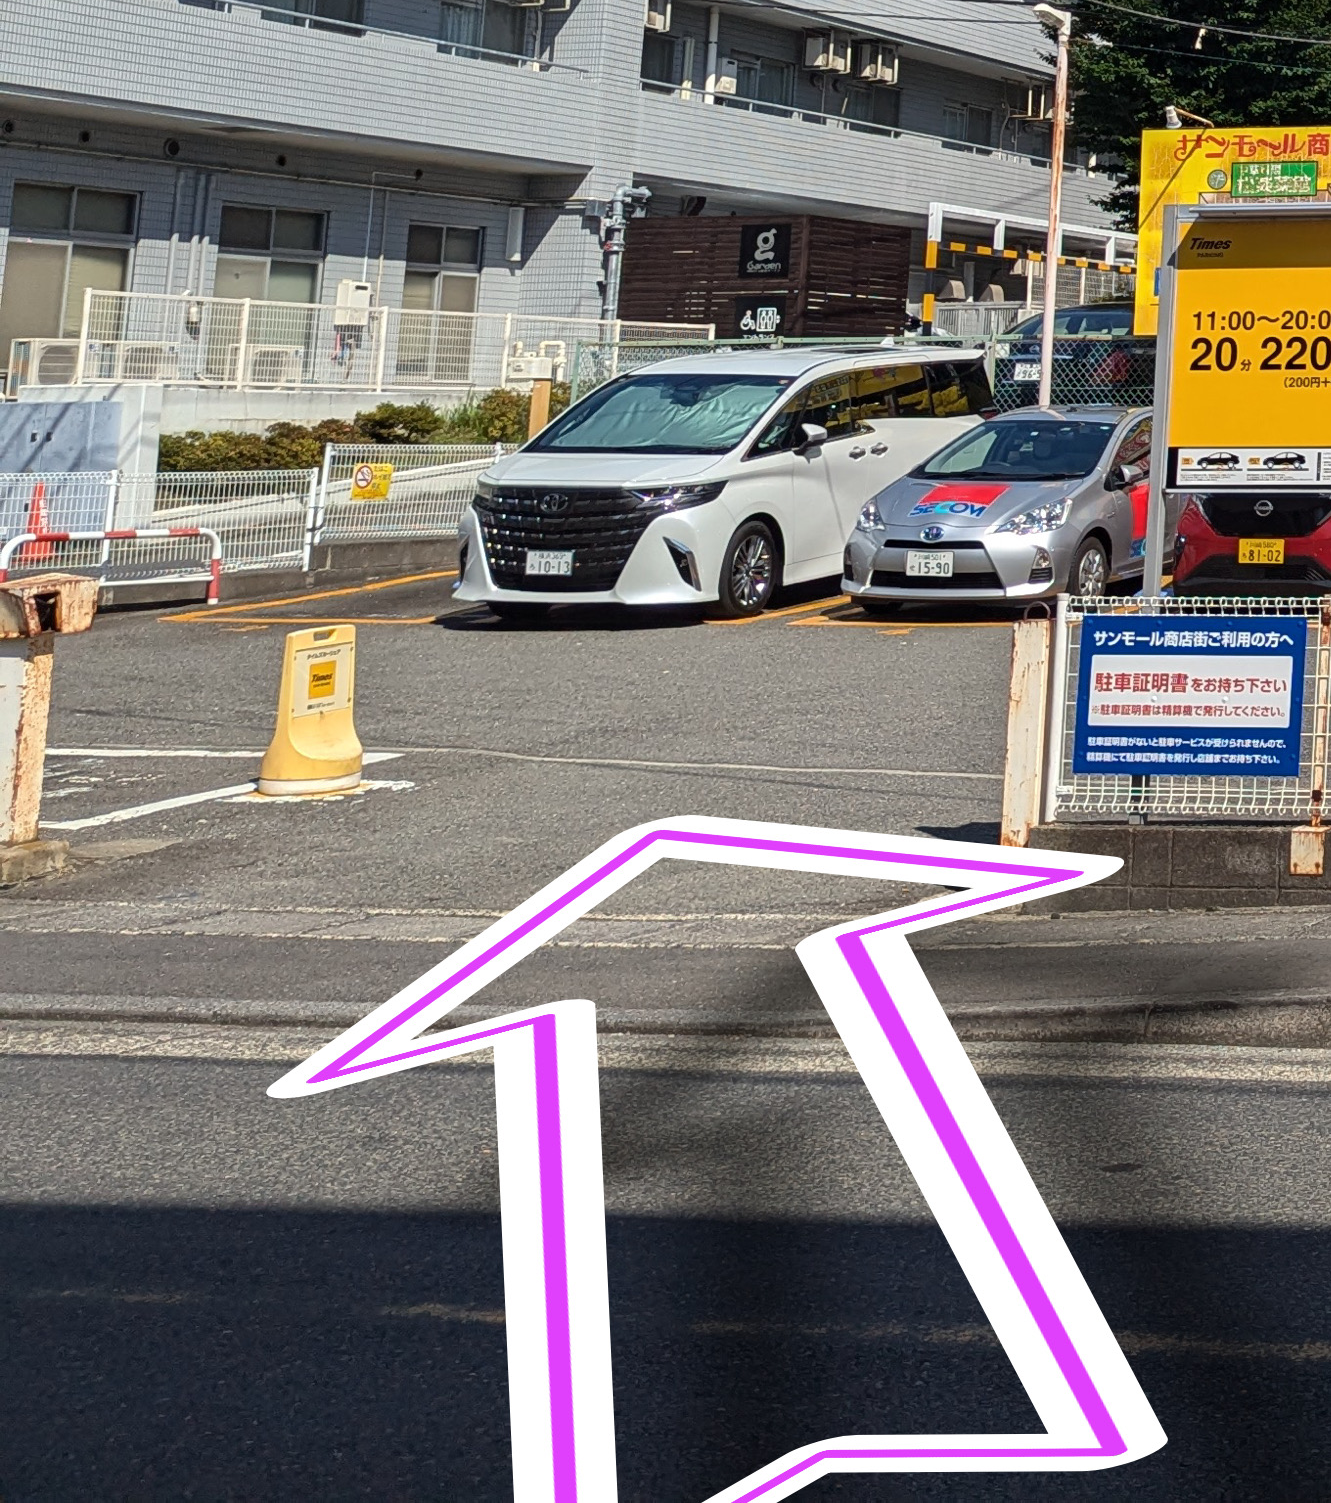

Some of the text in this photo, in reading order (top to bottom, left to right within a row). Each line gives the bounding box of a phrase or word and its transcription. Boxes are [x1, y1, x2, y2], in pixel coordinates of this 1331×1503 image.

[1190, 238, 1232, 250] Times
[909, 501, 987, 517] SECOM
[538, 560, 570, 574] 10-13
[917, 562, 950, 575] 15-90
[1093, 631, 1294, 648] サンモール商店街ご利用の方へ
[311, 673, 333, 684] Times
